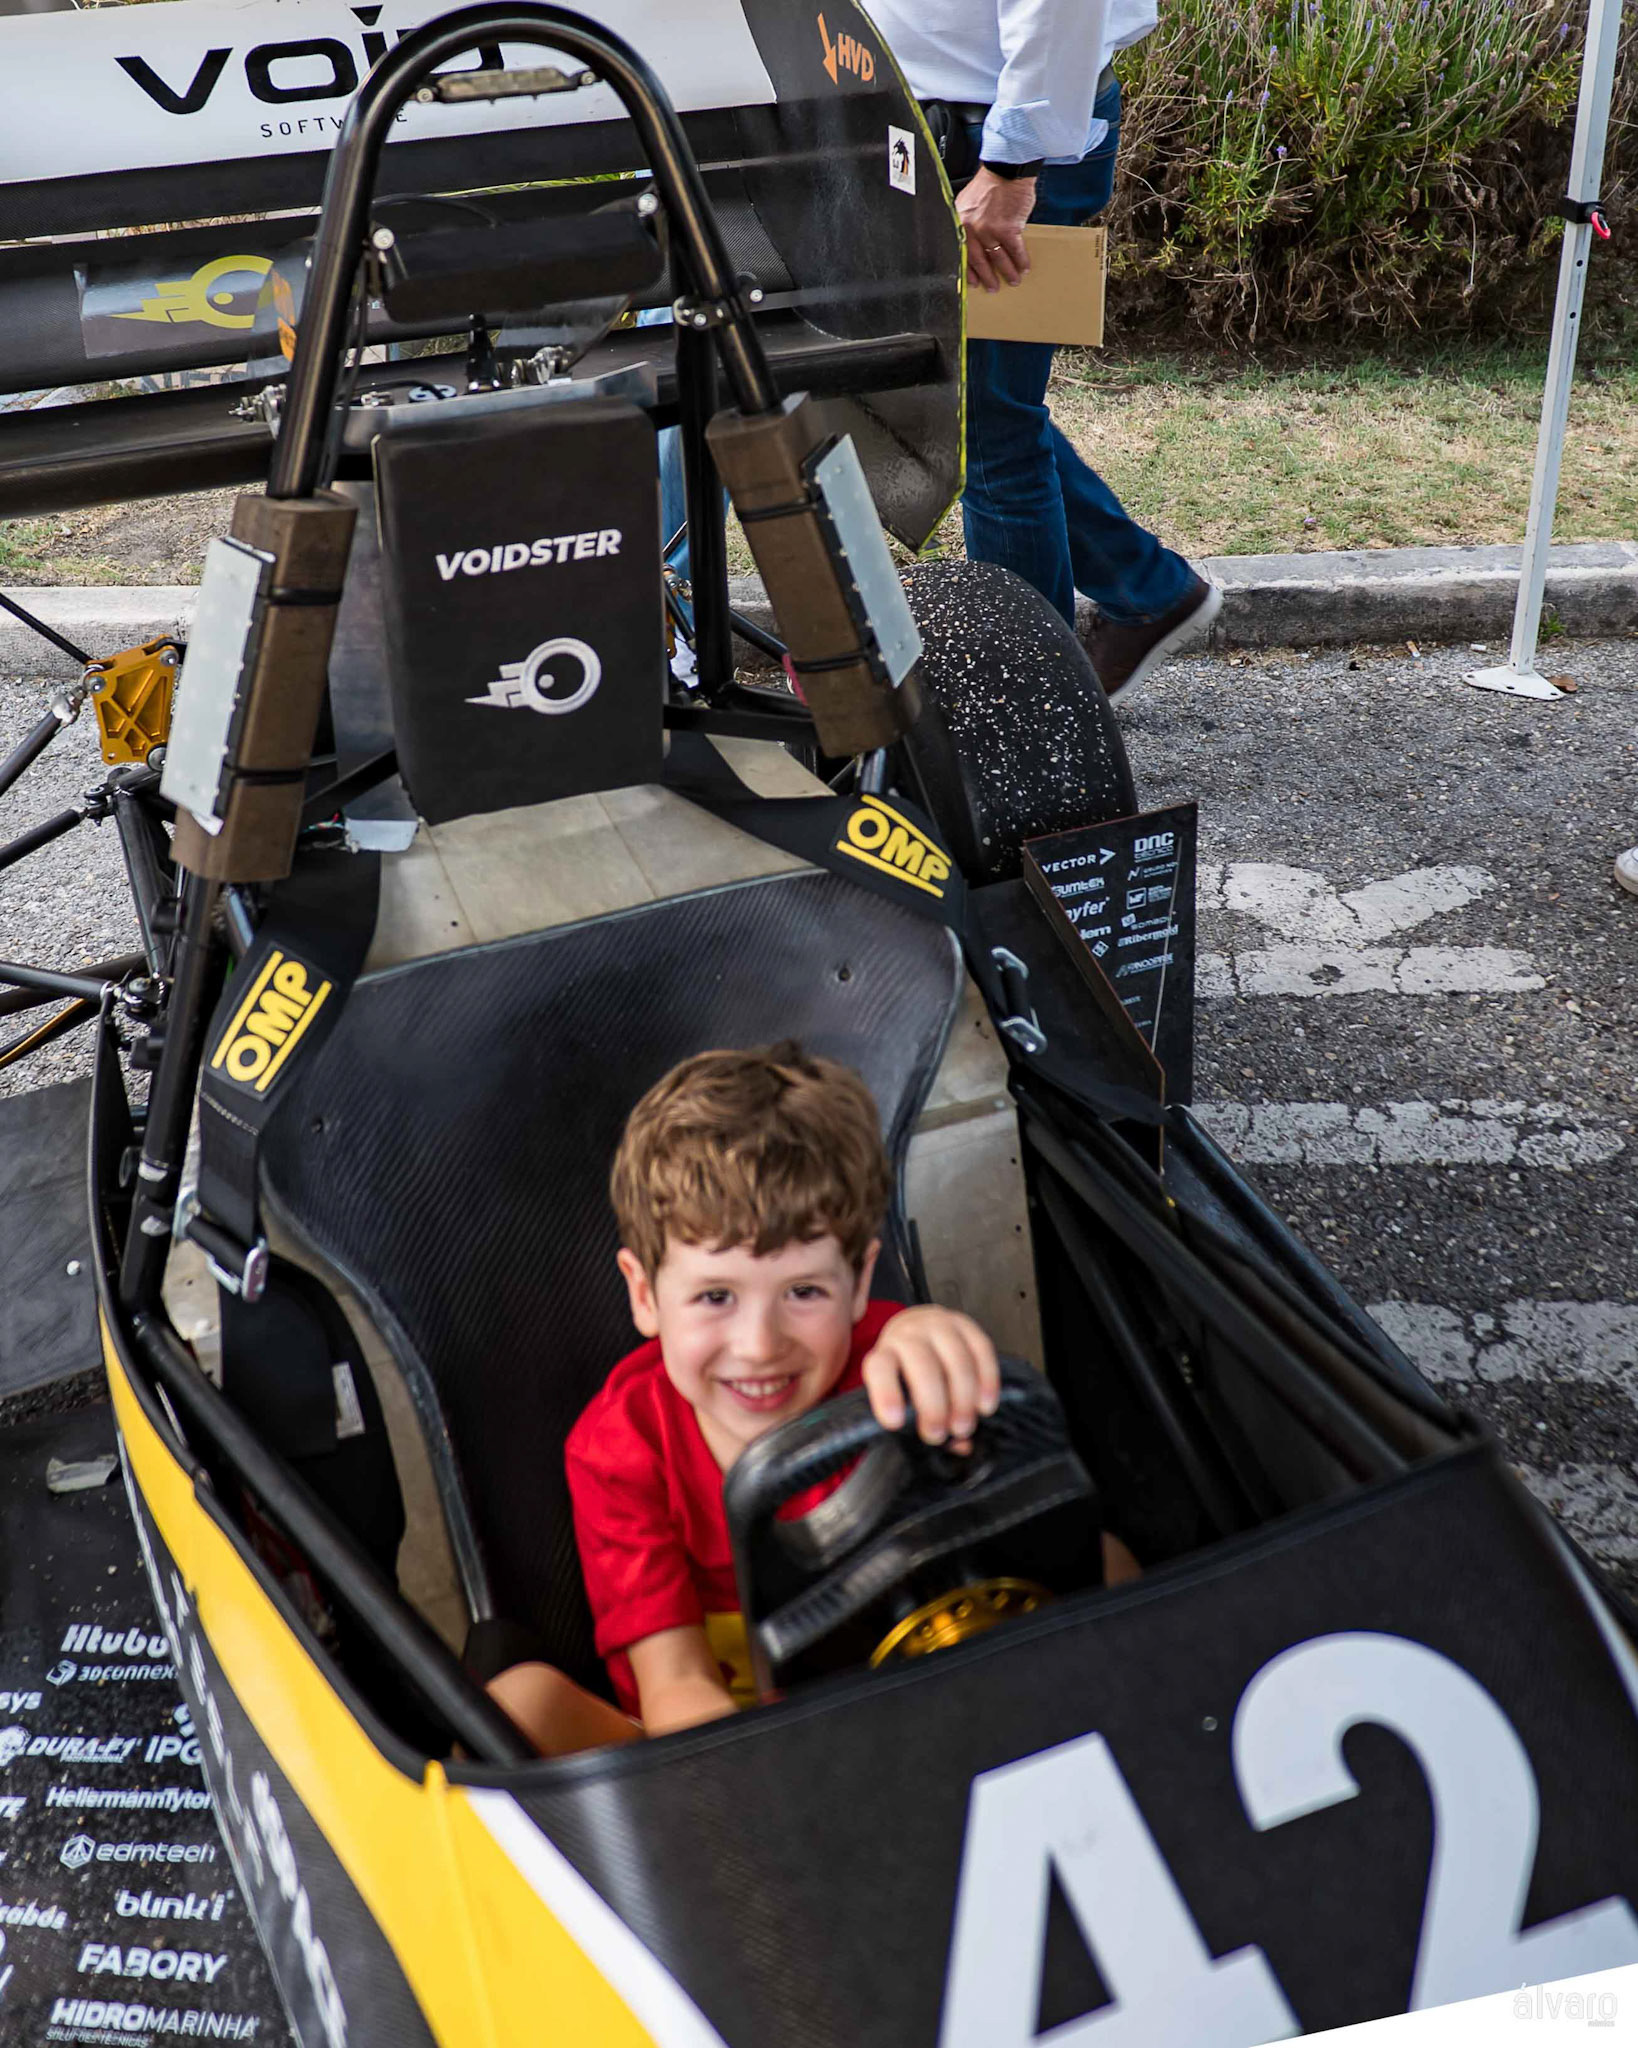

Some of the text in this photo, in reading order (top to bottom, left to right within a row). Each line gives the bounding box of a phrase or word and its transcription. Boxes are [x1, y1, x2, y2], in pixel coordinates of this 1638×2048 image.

[837, 32, 874, 81] HVD
[435, 529, 623, 581] VOIDSTER
[847, 807, 950, 882] OMP
[1042, 854, 1096, 873] VECTOR
[226, 960, 313, 1082] OMP
[144, 1734, 202, 1766] IPG
[938, 1630, 1638, 2048] 42
[77, 1943, 229, 1984] FABORY
[50, 1998, 258, 2040] HIDROMARINHA
